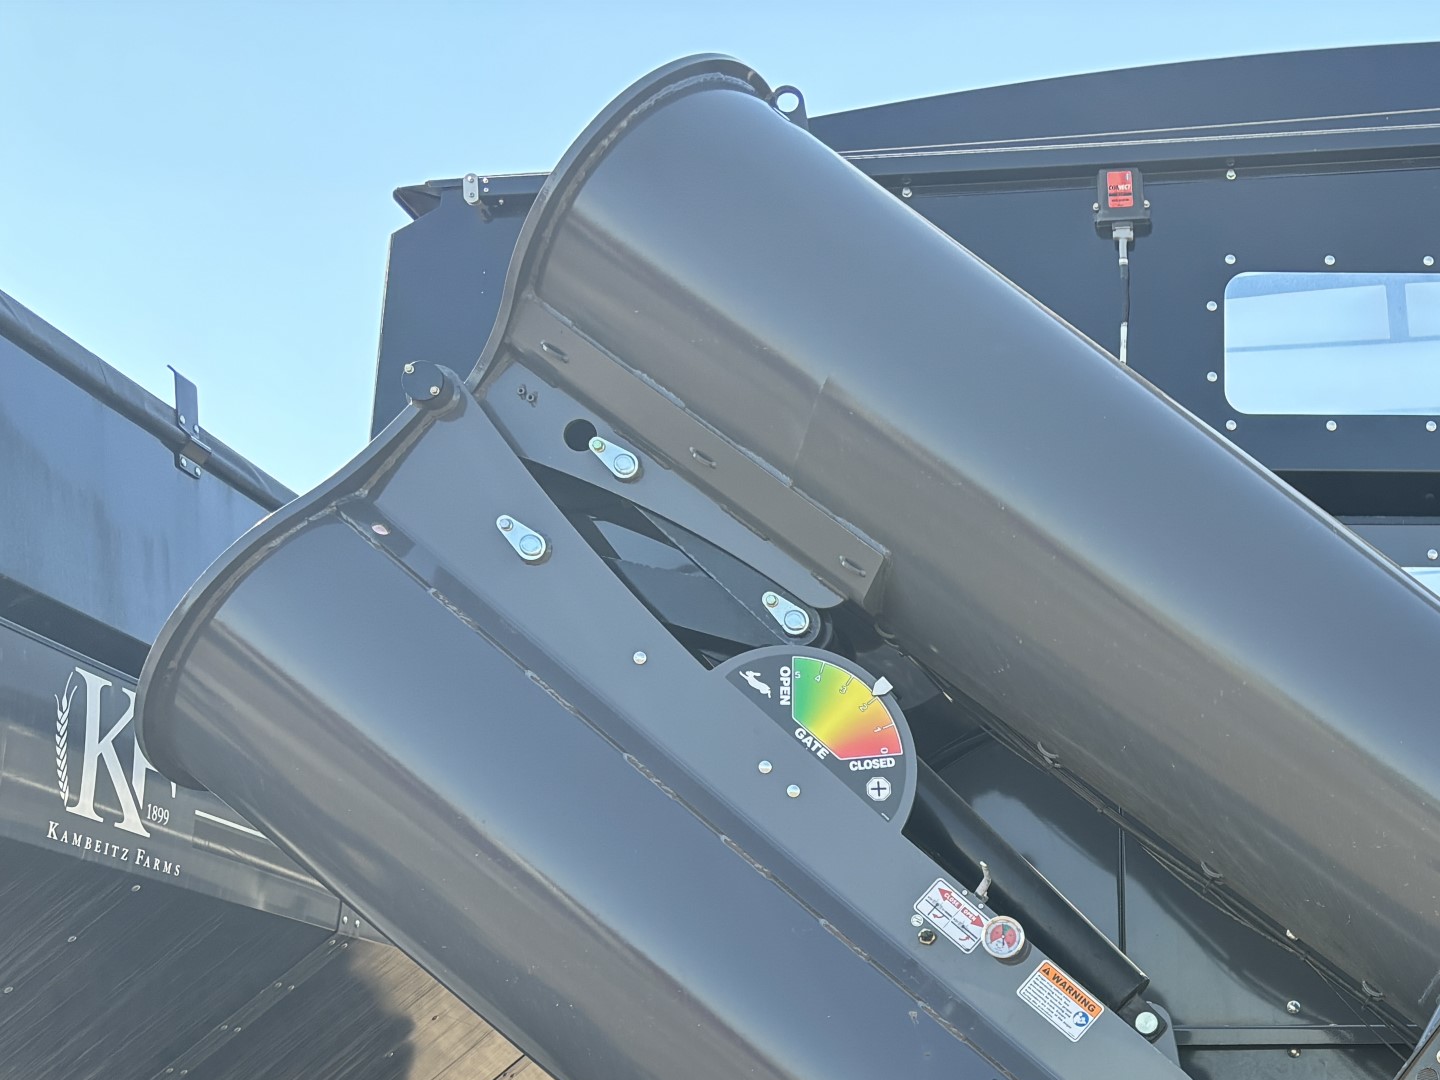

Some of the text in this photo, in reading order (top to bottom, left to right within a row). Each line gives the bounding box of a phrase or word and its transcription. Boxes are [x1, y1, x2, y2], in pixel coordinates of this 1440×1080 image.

[780, 666, 790, 705] OPEN
[795, 728, 829, 760] GATE
[849, 758, 895, 771] CLOSED
[146, 803, 170, 826] 1899
[943, 892, 959, 906] CLOSE
[962, 908, 976, 921] OPEN
[1050, 972, 1096, 1012] WARNING
